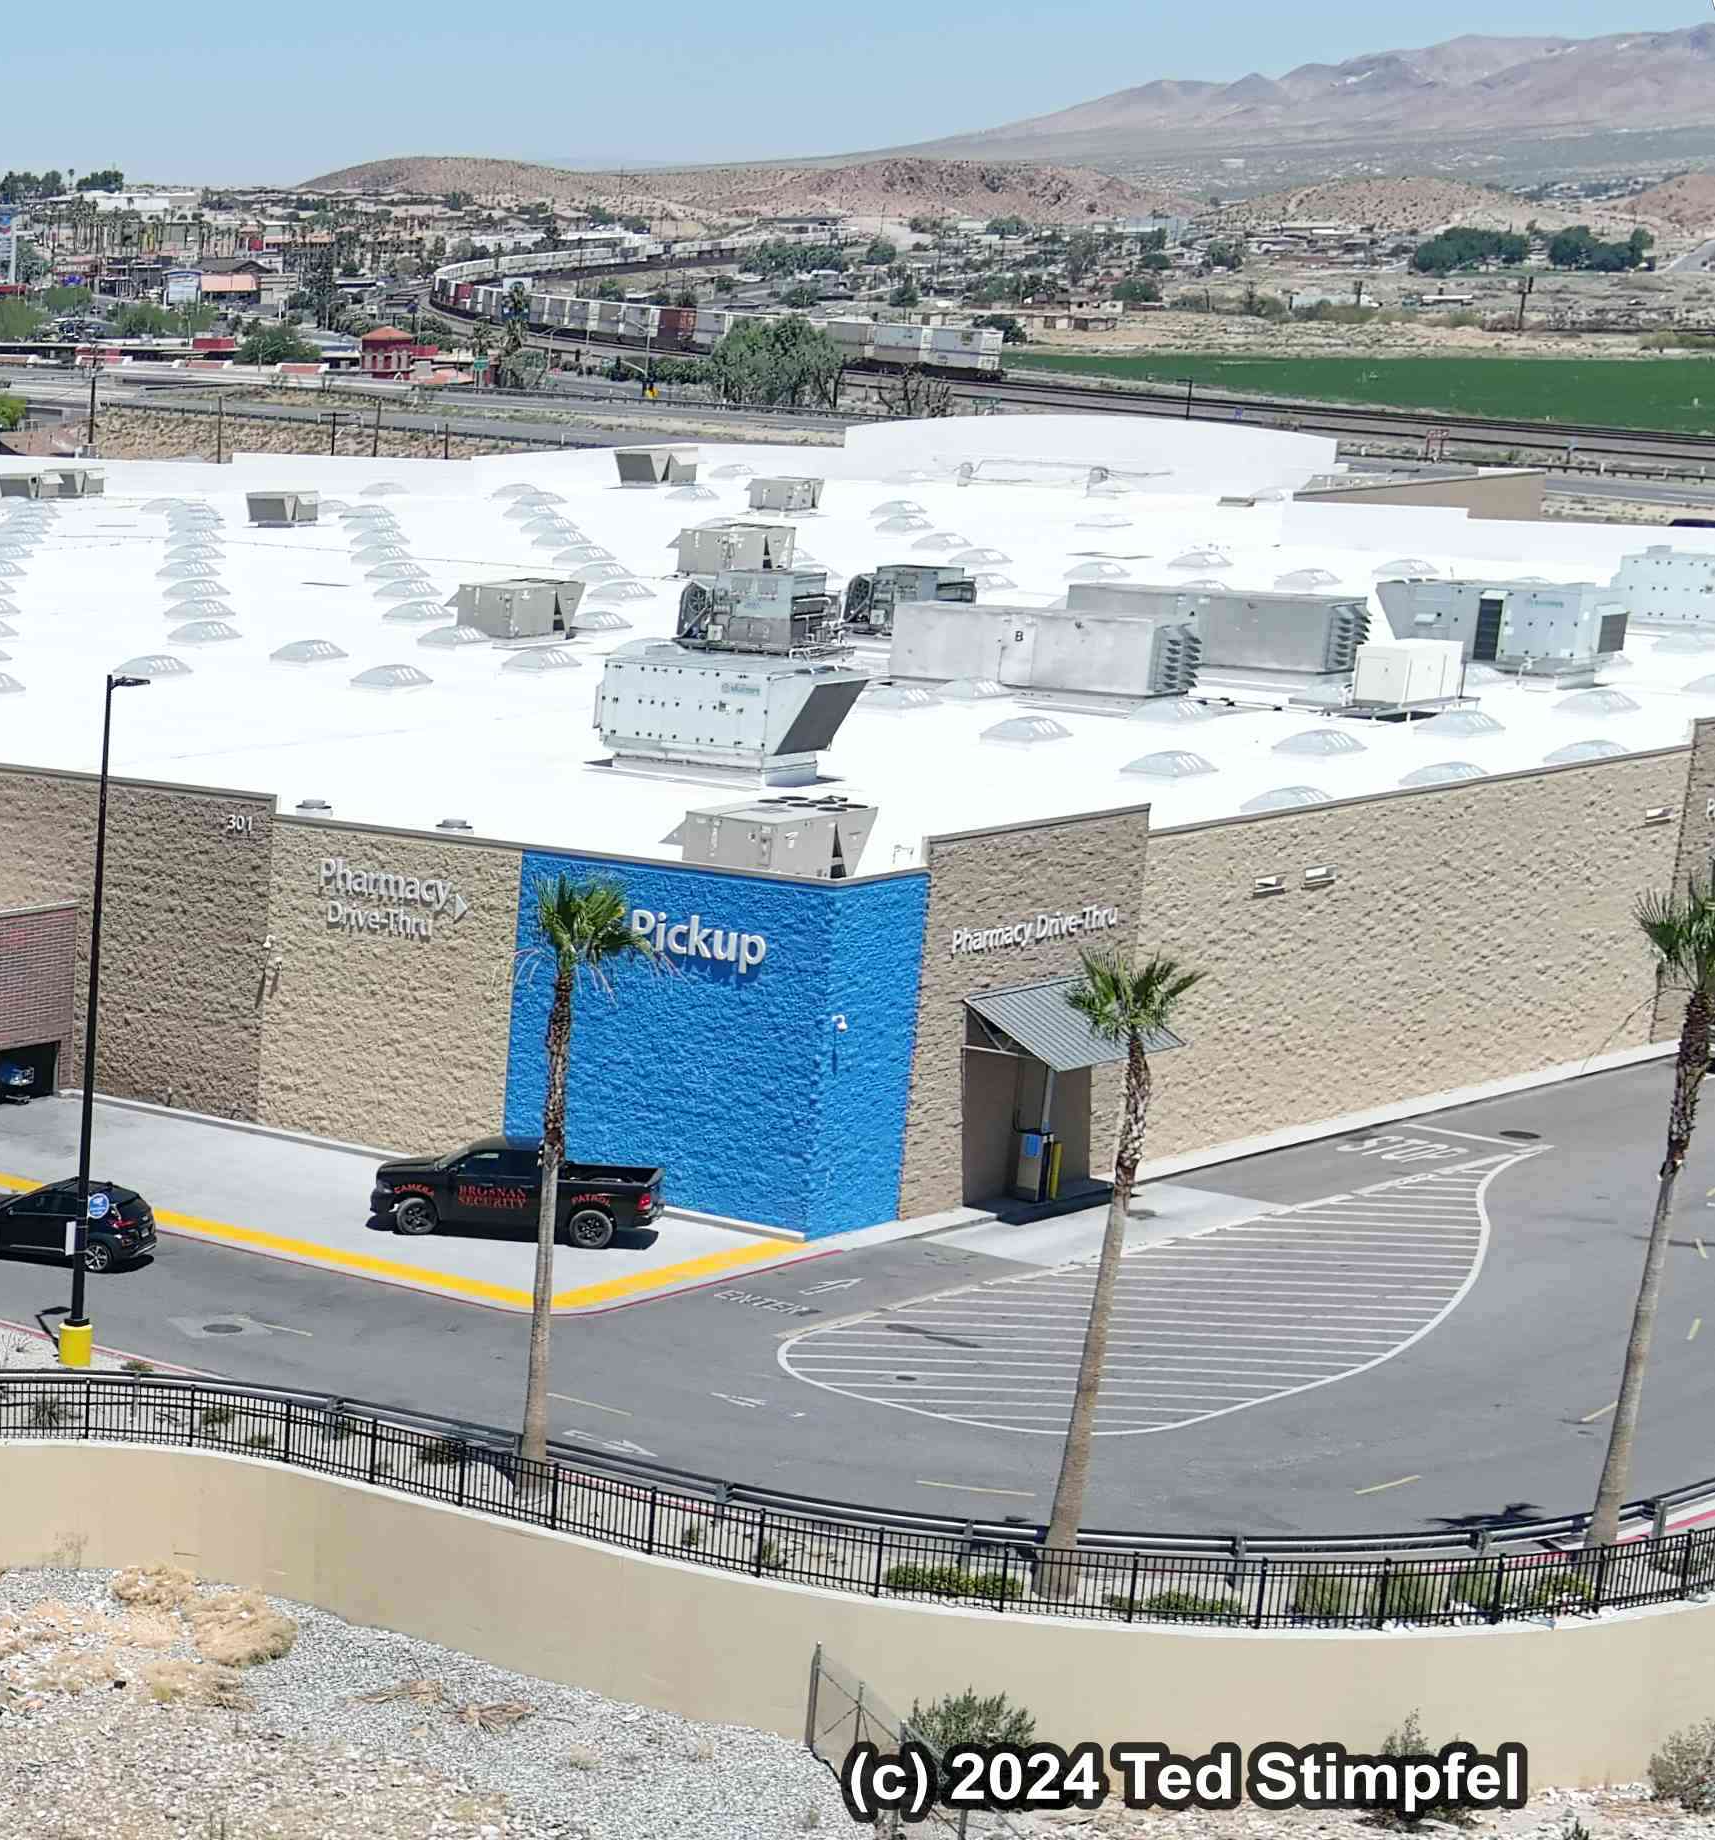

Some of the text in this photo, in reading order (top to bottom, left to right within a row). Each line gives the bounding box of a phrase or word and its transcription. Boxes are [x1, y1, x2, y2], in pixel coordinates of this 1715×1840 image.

[1015, 630, 1023, 642] B
[227, 814, 253, 831] 301
[321, 857, 452, 910] Pharmacy
[326, 900, 434, 939] Drive-Thru
[951, 905, 1119, 954] Pharmacy Drive-Thru
[630, 908, 767, 974] Pickup
[458, 1184, 527, 1197] BROSNAN
[570, 1193, 611, 1208] PATROL
[458, 1196, 528, 1209] SECURITY
[713, 1288, 812, 1315] ENTER
